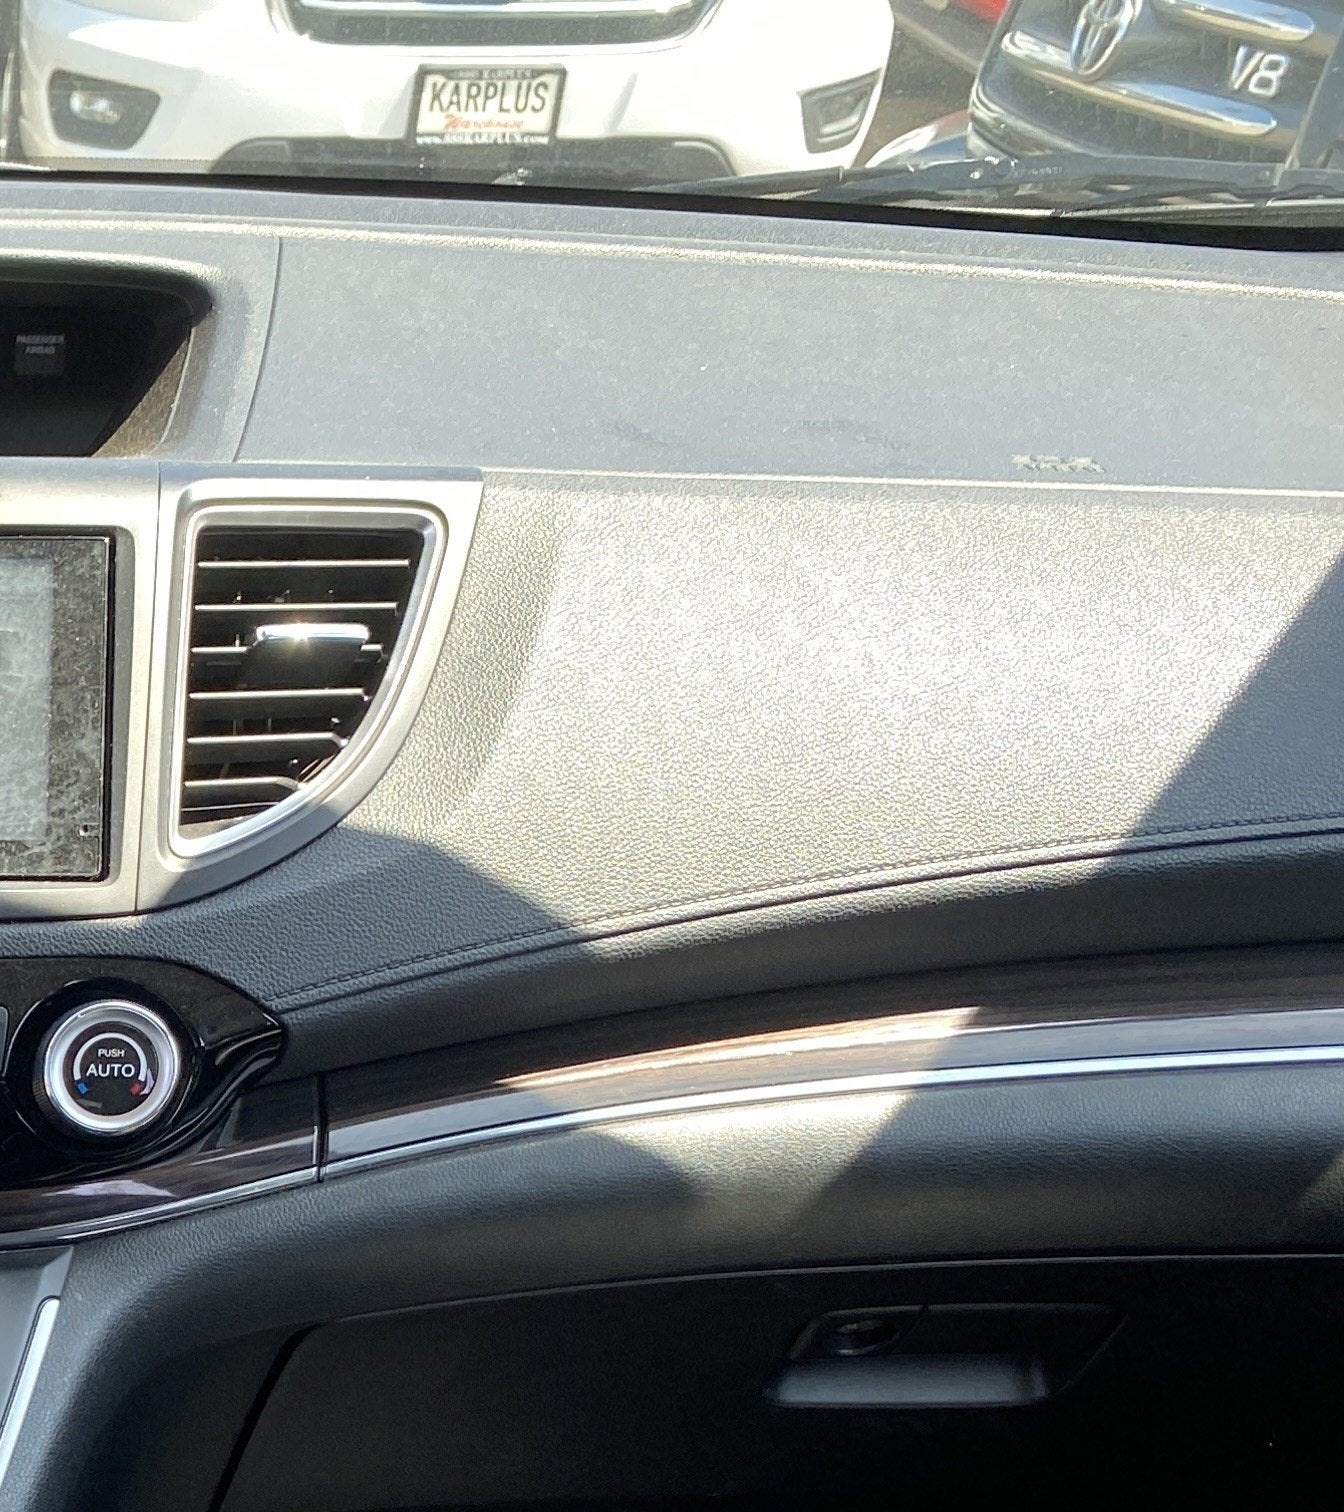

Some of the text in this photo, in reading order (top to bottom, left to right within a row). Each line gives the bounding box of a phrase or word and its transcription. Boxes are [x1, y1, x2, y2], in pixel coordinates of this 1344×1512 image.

[1230, 45, 1291, 96] V8
[429, 81, 548, 112] KARPLUS
[98, 1049, 125, 1058] PUSH
[86, 1064, 135, 1078] AUTO
